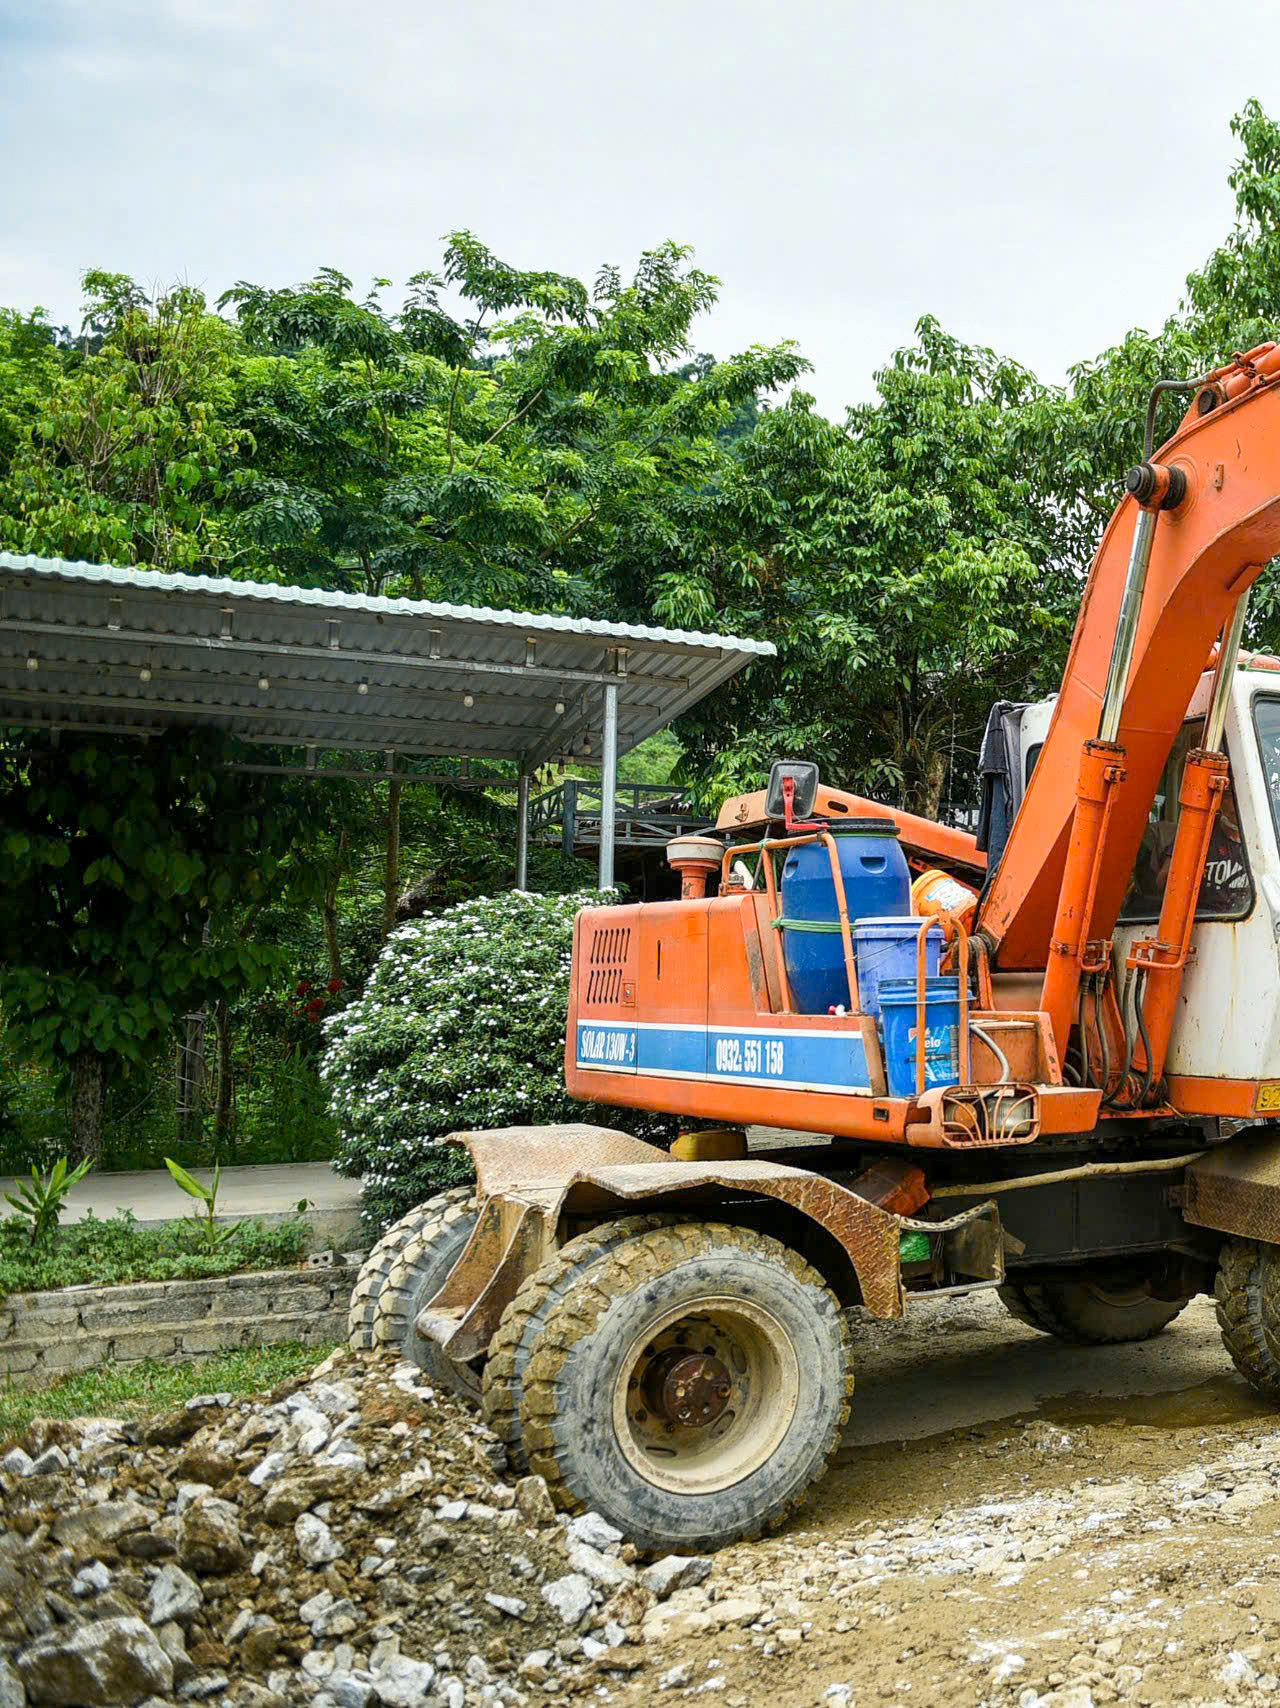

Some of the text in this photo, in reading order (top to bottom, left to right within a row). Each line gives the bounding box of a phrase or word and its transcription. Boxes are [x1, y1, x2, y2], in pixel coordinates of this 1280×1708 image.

[581, 1030, 605, 1059] SOLAR
[923, 1036, 941, 1048] elo
[744, 1039, 762, 1073] 551
[765, 1041, 784, 1075] 158
